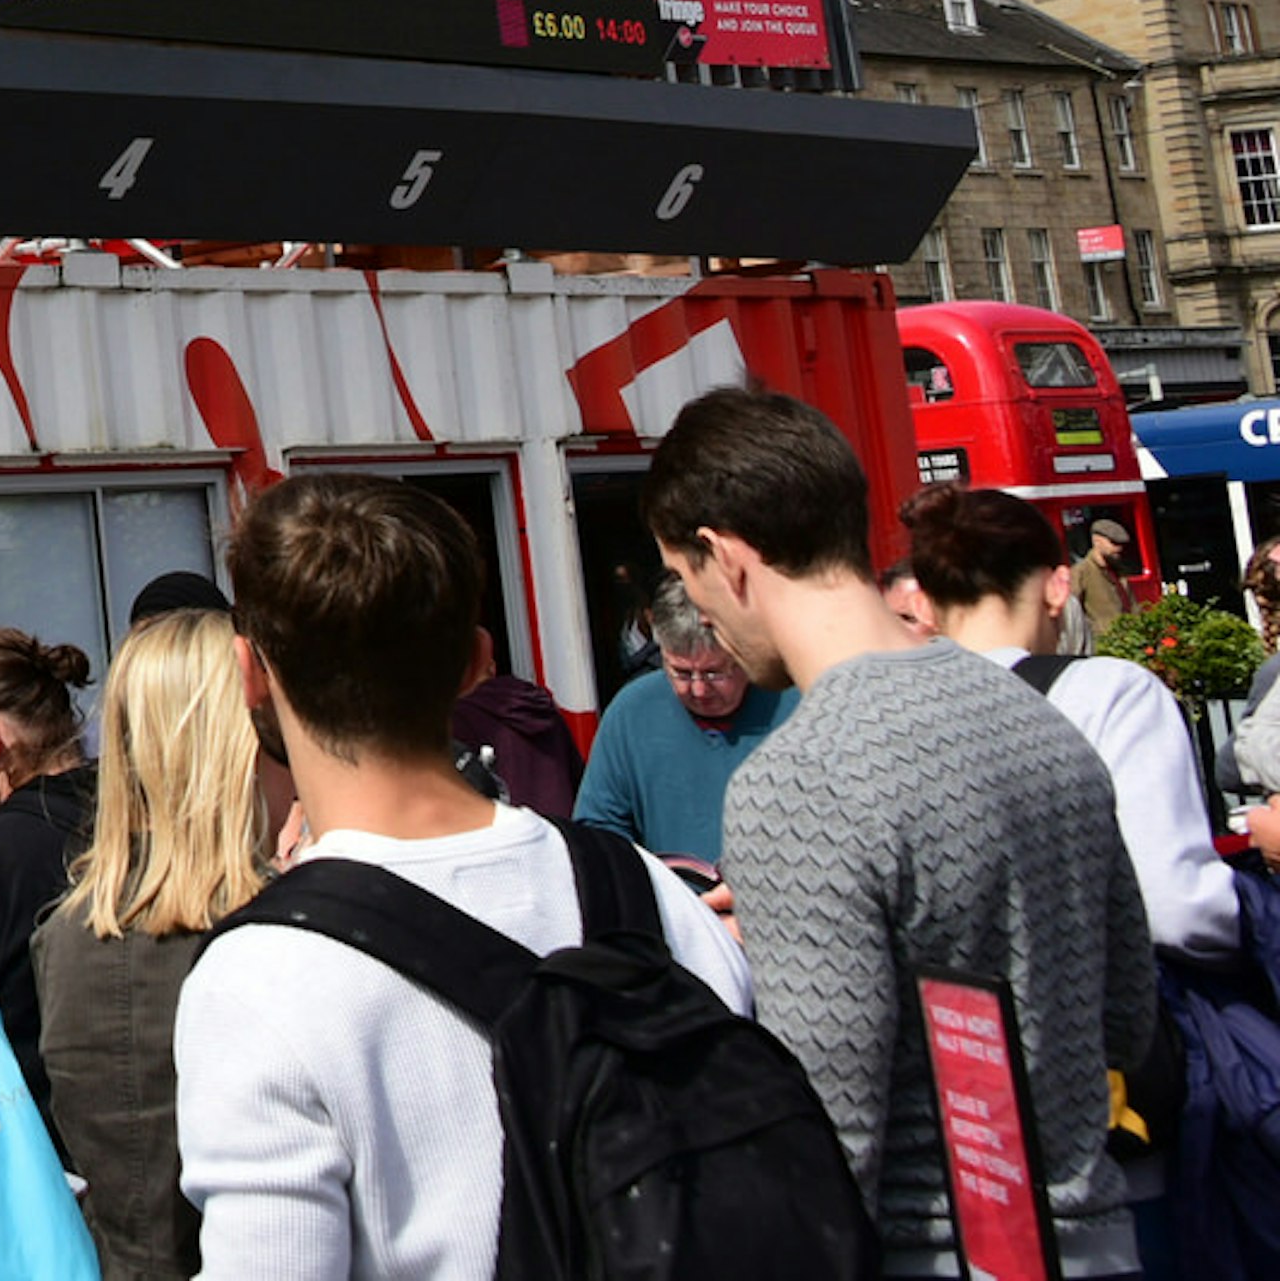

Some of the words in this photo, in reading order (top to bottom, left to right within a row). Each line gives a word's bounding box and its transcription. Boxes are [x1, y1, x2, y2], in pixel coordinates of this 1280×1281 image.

[533, 12, 585, 39] £6.00
[597, 19, 646, 45] 14:00
[714, 1, 742, 14] MAKE
[743, 2, 770, 15] YOUR
[772, 4, 808, 17] CHOICE
[717, 19, 738, 31] AND
[740, 20, 763, 32] JOIN
[765, 21, 783, 33] THE
[785, 22, 818, 36] QUEUE
[99, 138, 153, 198] 4
[390, 151, 442, 209] 5
[656, 164, 703, 219] 6
